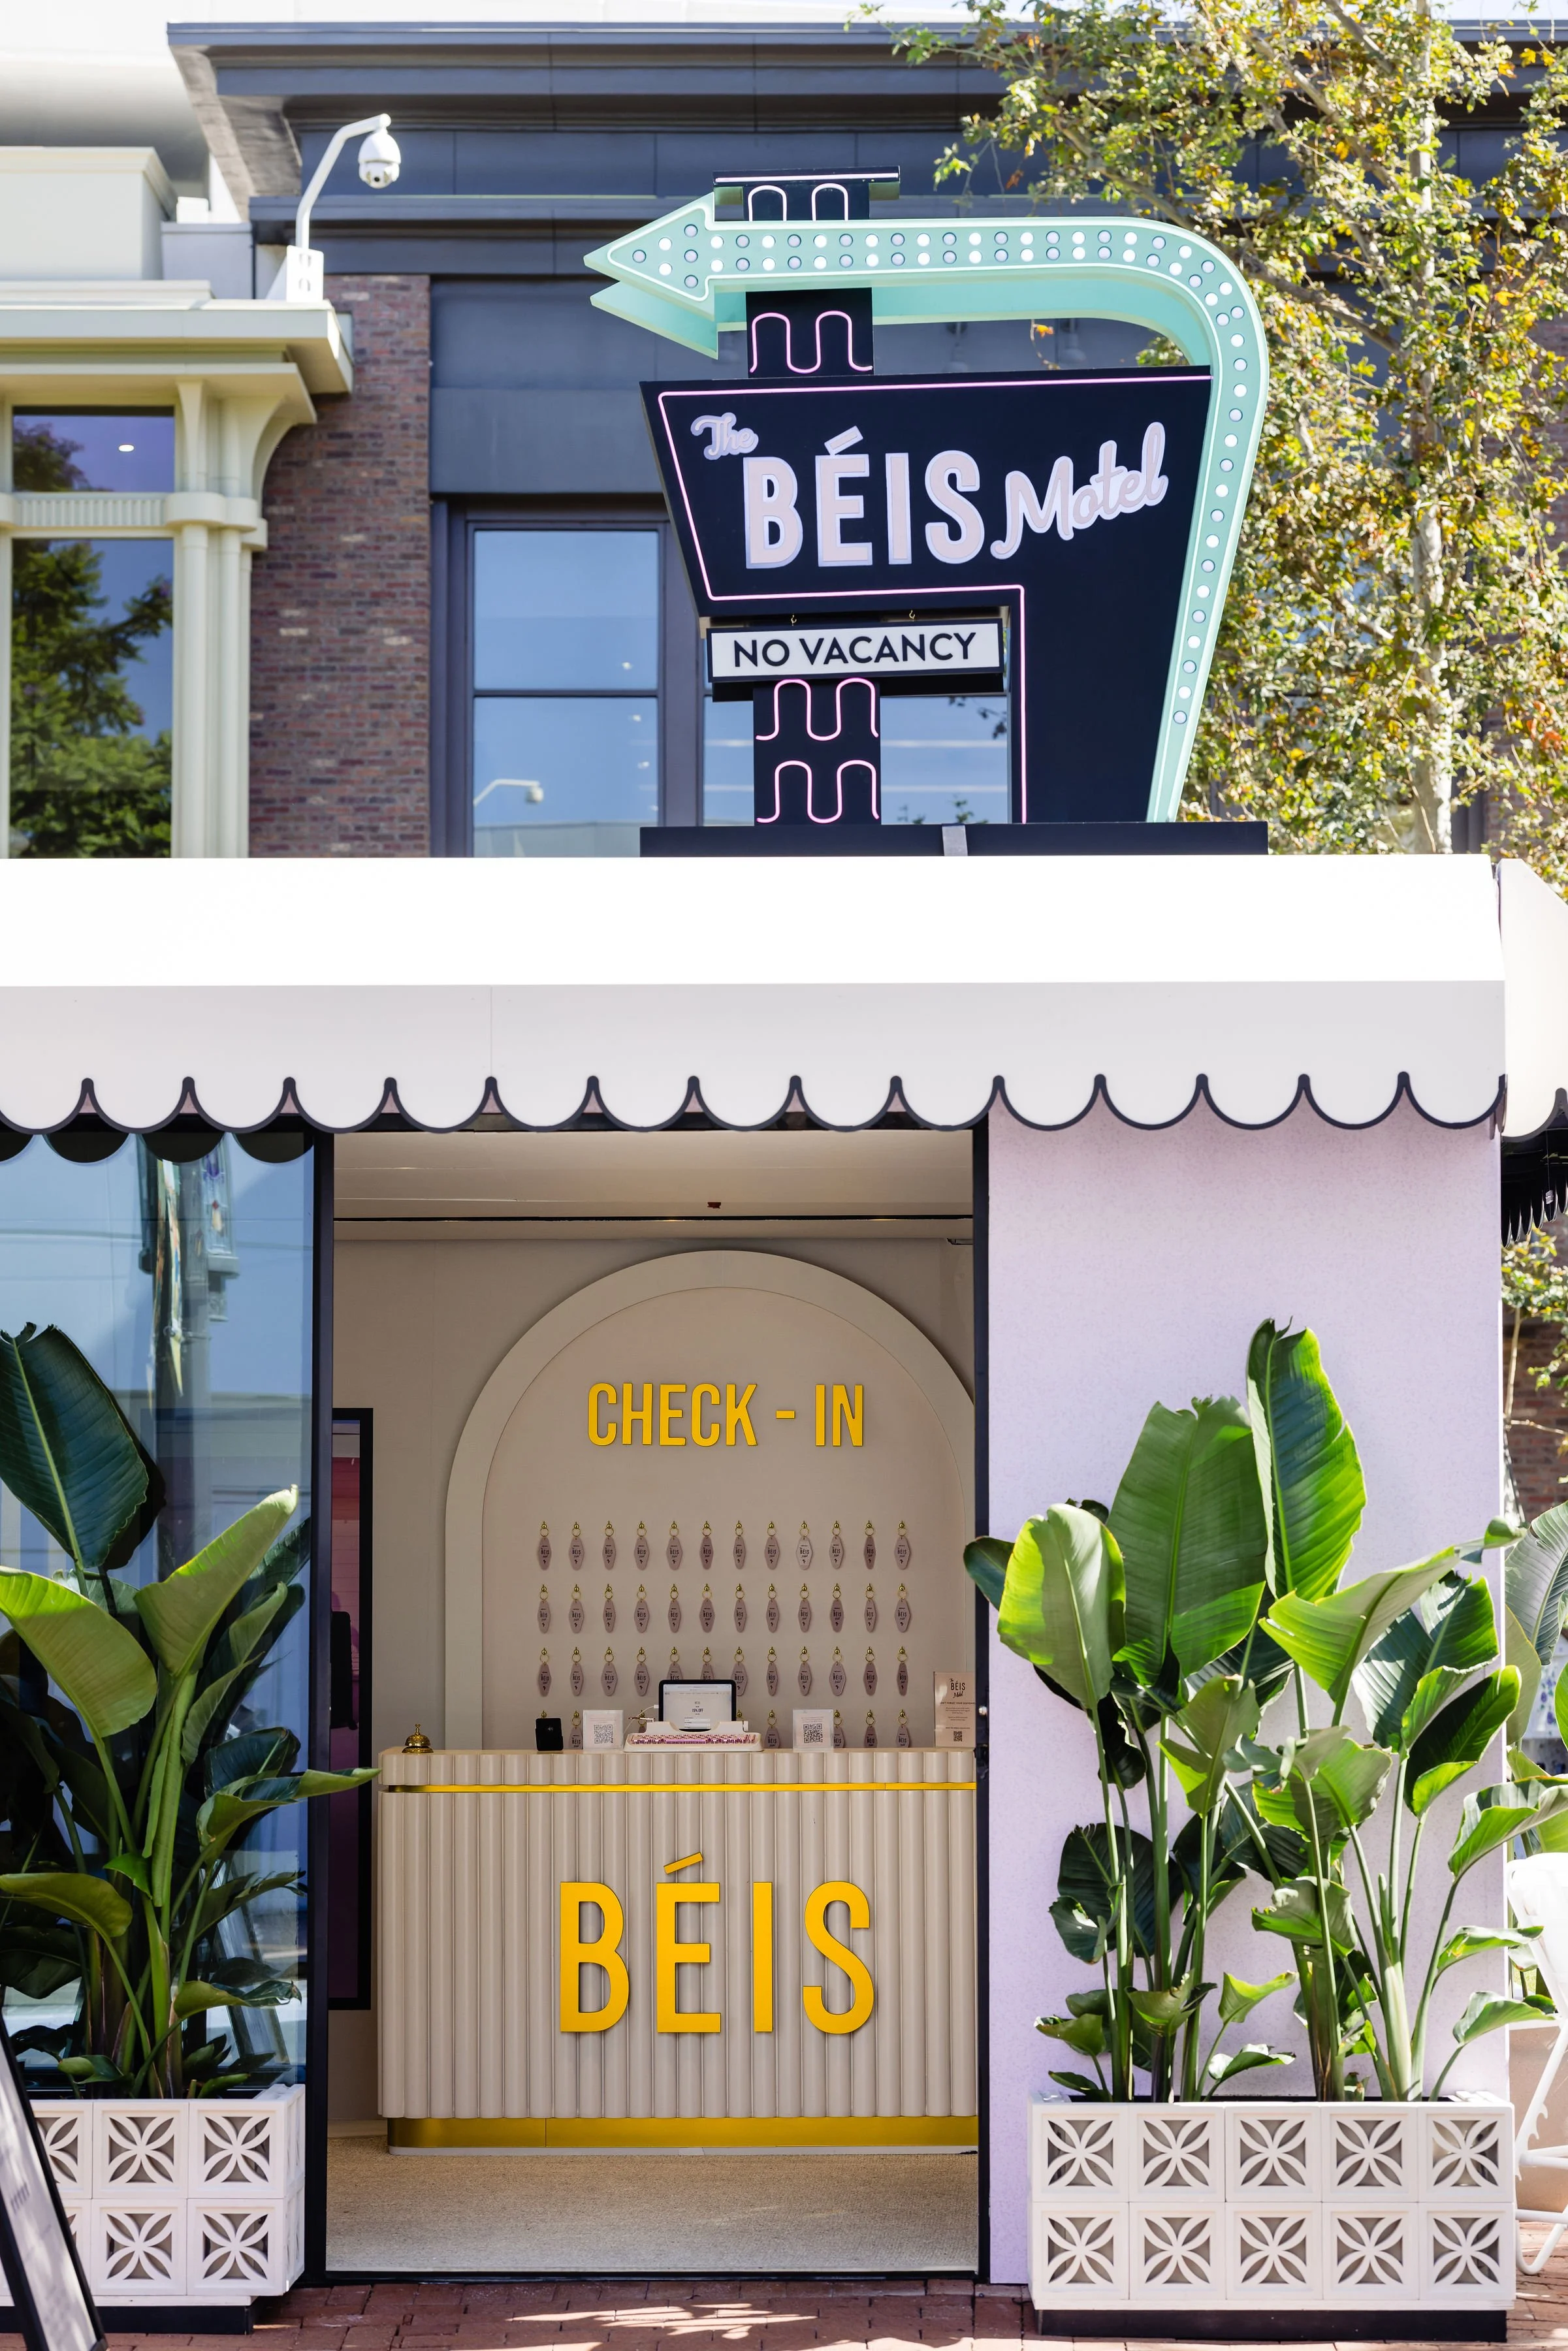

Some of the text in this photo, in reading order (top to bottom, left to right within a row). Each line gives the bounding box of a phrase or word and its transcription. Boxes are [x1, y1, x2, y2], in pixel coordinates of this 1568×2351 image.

[690, 412, 758, 461] The
[743, 421, 1168, 569] BÉIS Motel
[733, 632, 977, 667] NO VACANCY
[587, 1383, 758, 1447] CHECK
[815, 1384, 864, 1447] IN
[951, 1680, 966, 1691] BÉIS
[560, 1851, 874, 2034] BÉIS
